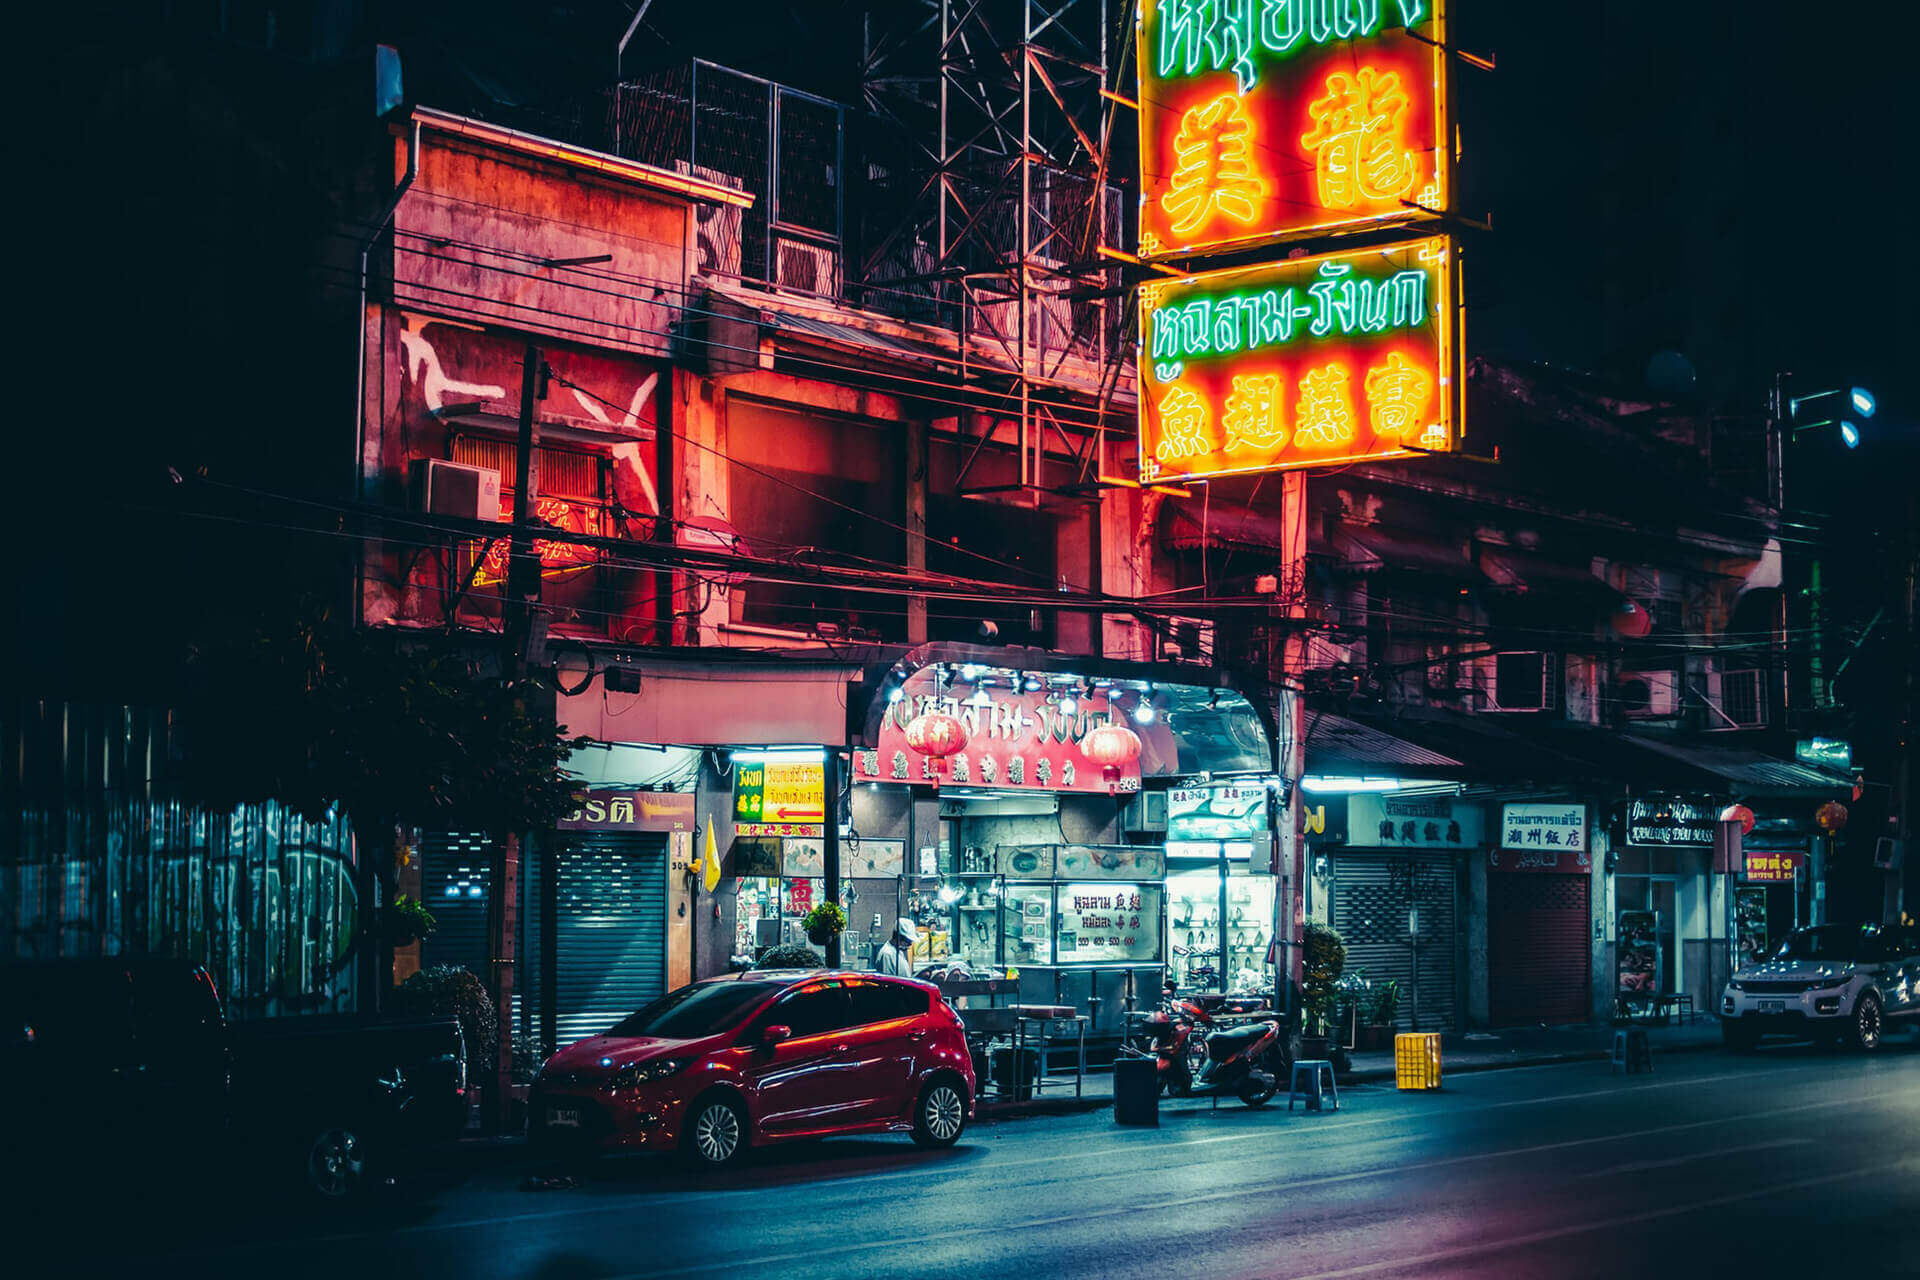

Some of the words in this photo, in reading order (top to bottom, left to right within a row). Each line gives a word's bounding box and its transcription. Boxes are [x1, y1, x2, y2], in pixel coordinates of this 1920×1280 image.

[1152, 261, 1426, 382] หูฉลาม-รังนก
[1508, 828, 1580, 847] 潮州飯店
